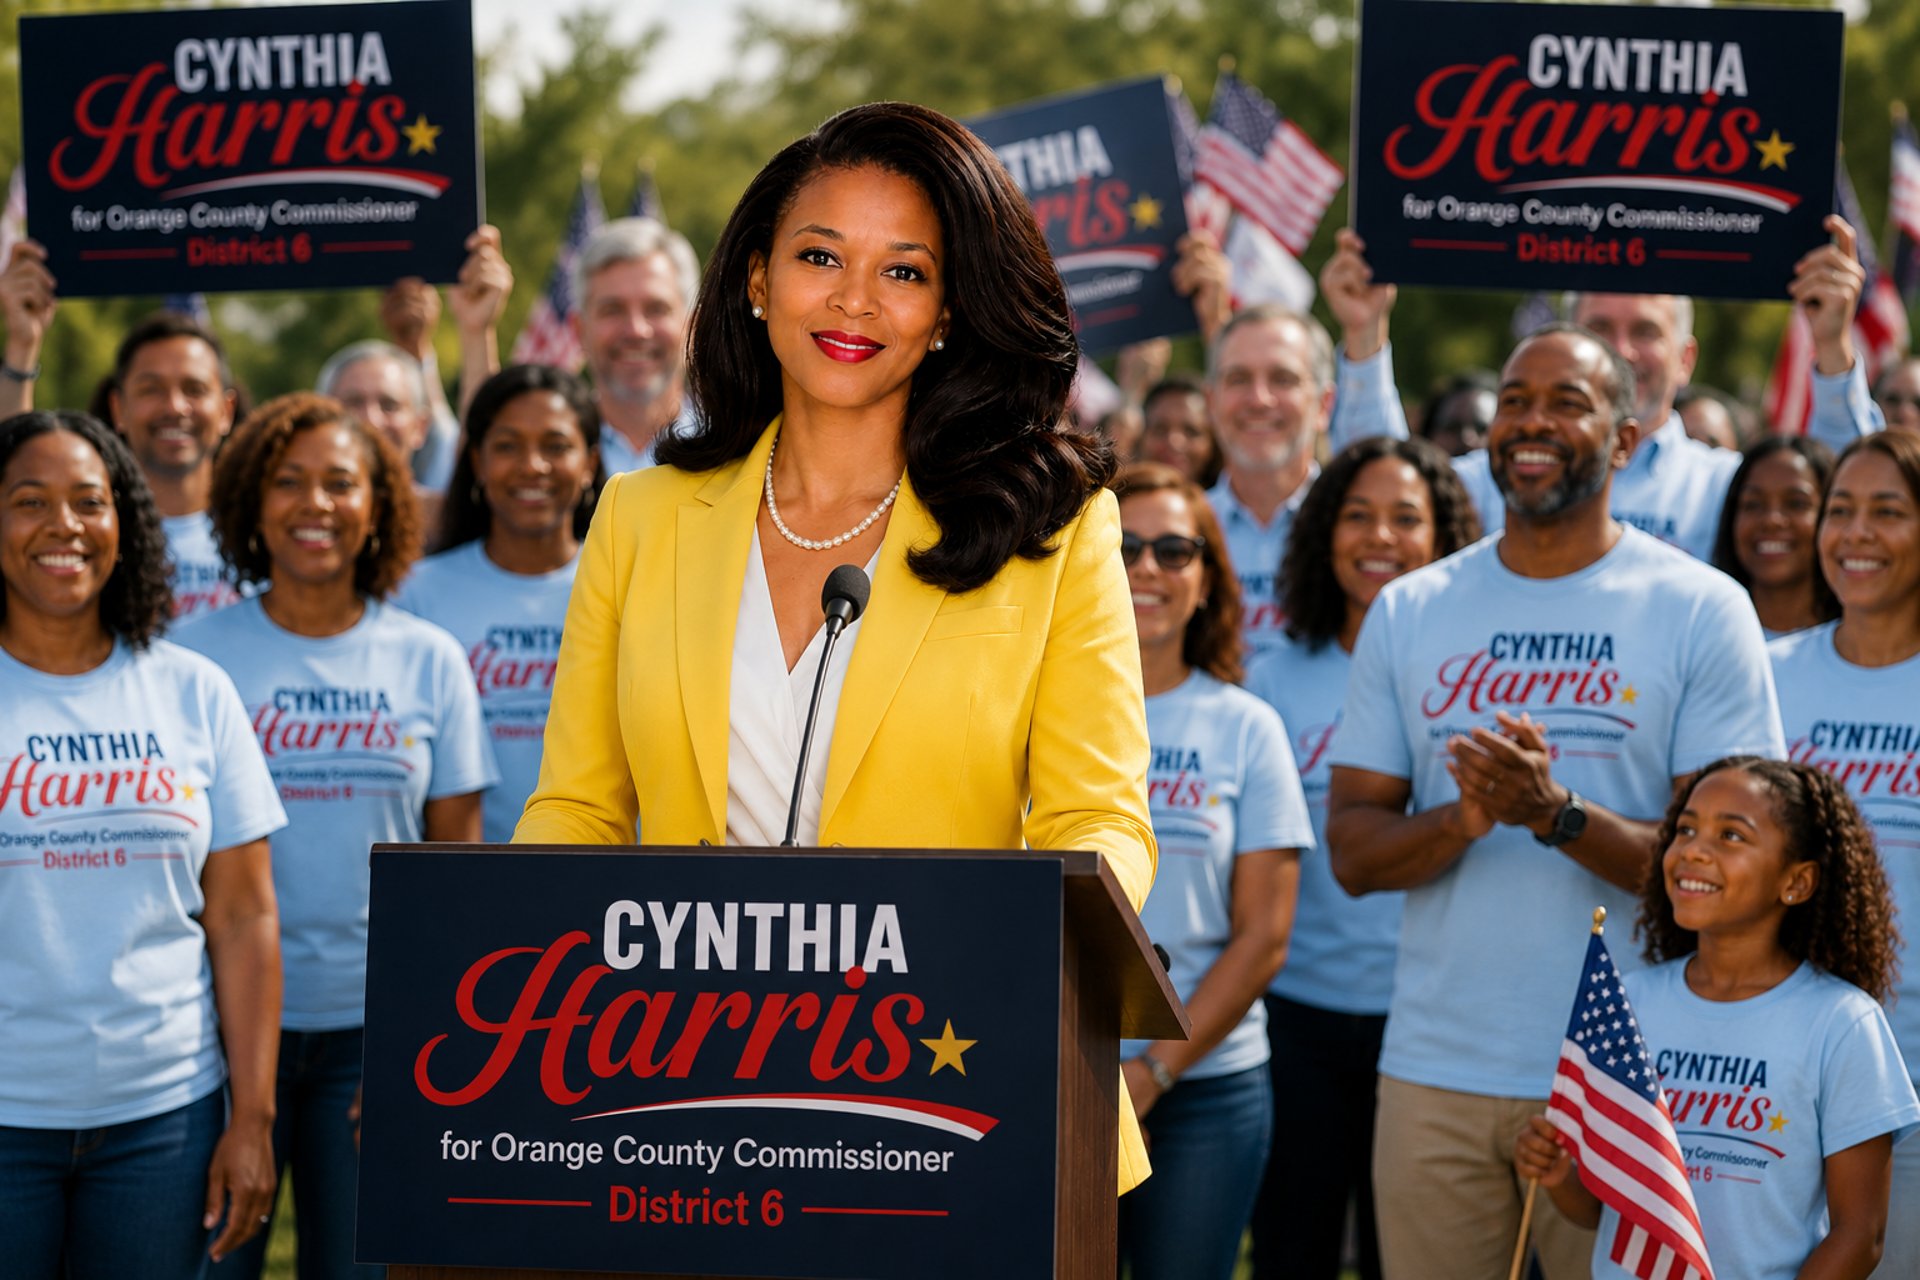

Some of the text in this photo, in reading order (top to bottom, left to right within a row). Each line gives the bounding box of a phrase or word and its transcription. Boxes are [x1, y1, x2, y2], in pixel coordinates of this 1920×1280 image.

[174, 32, 391, 93] CYNTHIA
[1528, 33, 1747, 96] CYNTHIA
[49, 62, 406, 191] Harris
[1383, 55, 1760, 181] Harris
[996, 125, 1114, 193] THIA
[71, 197, 419, 234] for Orange County Commissioner
[1032, 176, 1130, 247] ris
[1403, 193, 1763, 233] for Orange County Commissioner
[187, 233, 312, 266] District 6
[1516, 233, 1646, 266] District 6
[1489, 632, 1614, 661] CYNTHIA
[273, 687, 391, 712] CYNTHIA
[1421, 648, 1619, 719] Harris
[27, 732, 164, 762] CYNTHIA
[49, 829, 96, 846] County
[43, 848, 126, 870] District 6
[603, 900, 908, 973] CYNTHIA
[414, 931, 924, 1106] Harris
[1656, 1049, 1767, 1088] CYNTHIA
[1662, 1085, 1772, 1132] arris
[440, 1131, 954, 1174] for Orange County Commissioner
[1704, 1165, 1712, 1183] 6
[609, 1186, 784, 1226] District 6
